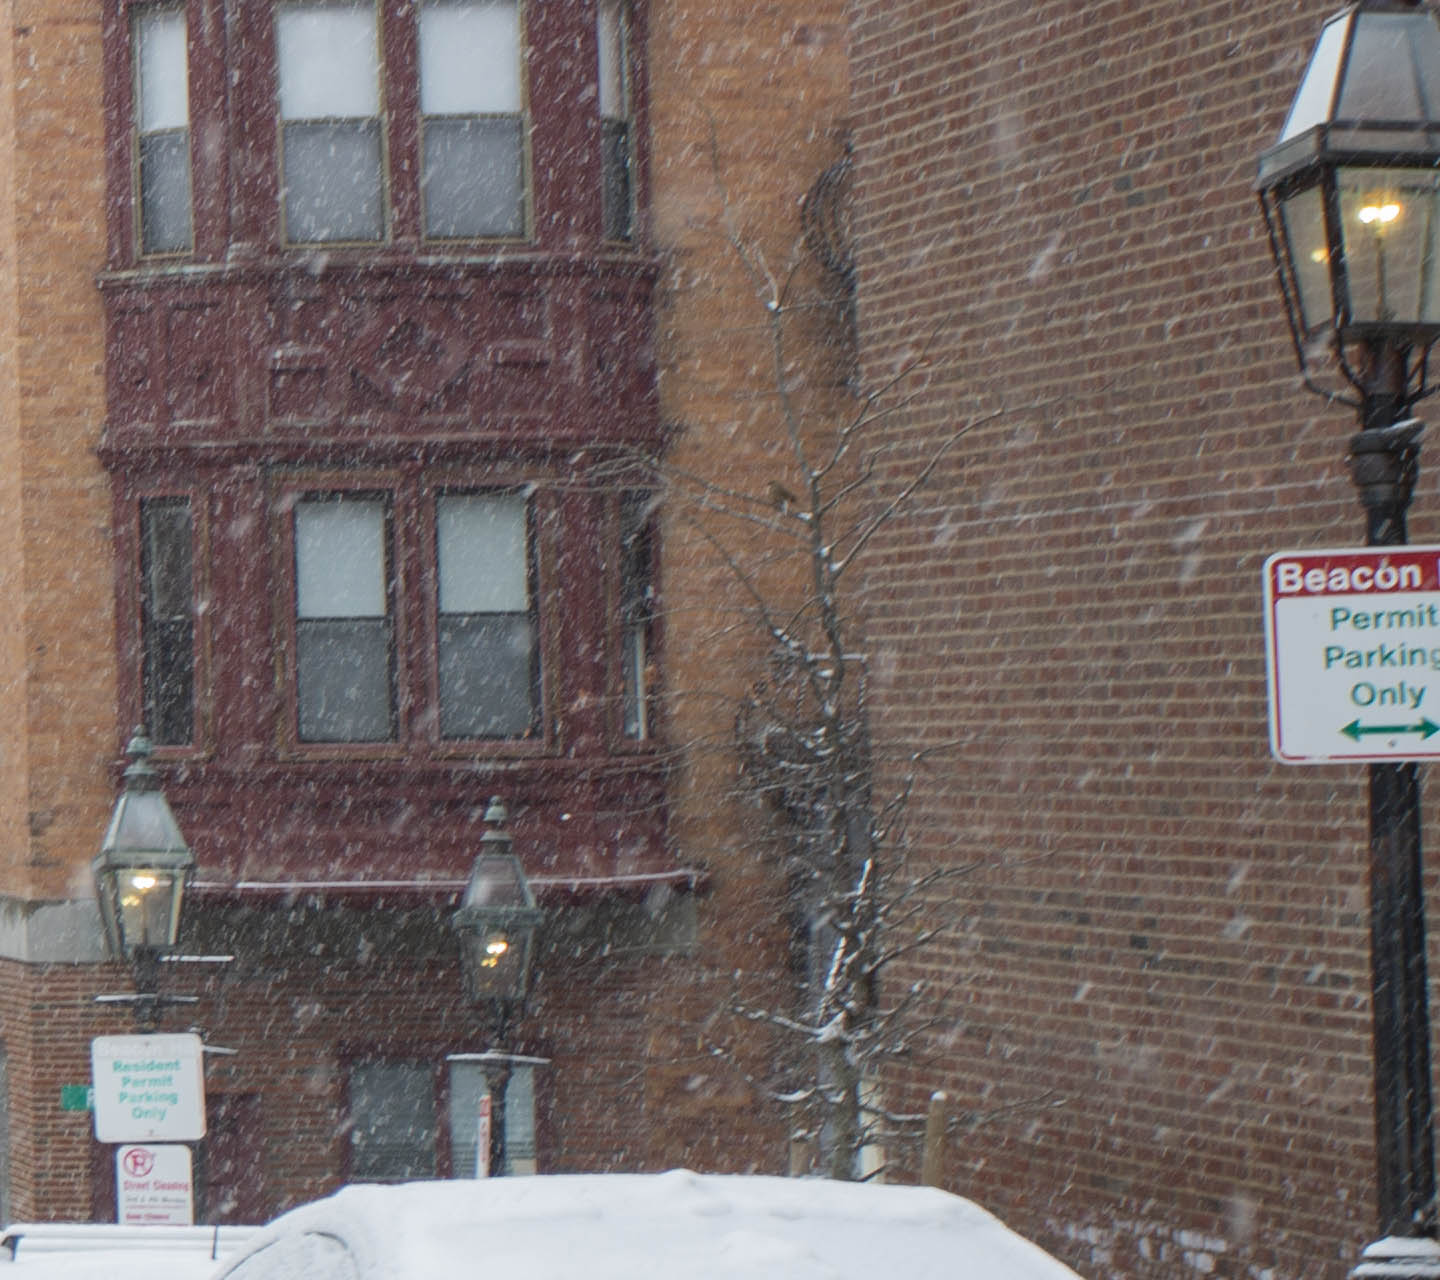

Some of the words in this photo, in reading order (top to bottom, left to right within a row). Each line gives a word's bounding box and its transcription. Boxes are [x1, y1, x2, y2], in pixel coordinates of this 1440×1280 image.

[1277, 561, 1422, 593] Beacon
[1329, 603, 1439, 632] Permit
[1350, 681, 1427, 710] Only
[113, 1059, 181, 1072] Resident
[121, 1074, 174, 1087] Permit
[118, 1090, 179, 1105] Parking
[131, 1106, 167, 1121] Only
